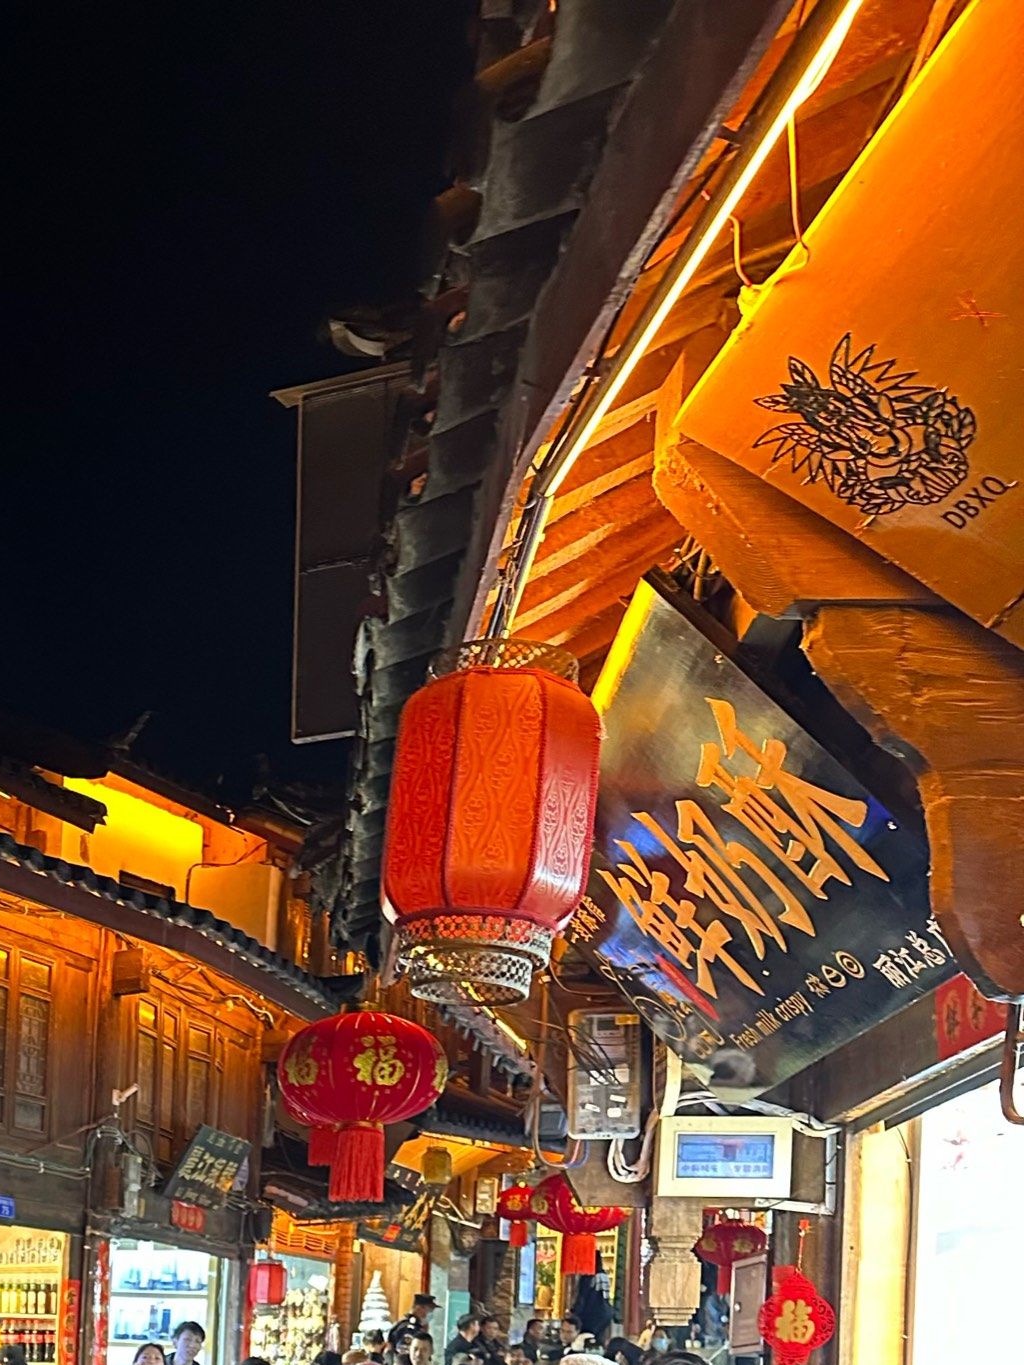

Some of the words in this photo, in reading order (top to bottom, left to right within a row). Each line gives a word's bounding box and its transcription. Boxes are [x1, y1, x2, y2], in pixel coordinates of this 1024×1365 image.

[940, 476, 1018, 530] DBXQ
[595, 697, 891, 999] 鲜奶酥
[729, 1022, 764, 1052] Fresh
[755, 1008, 783, 1037] milk
[774, 990, 815, 1023] crispy
[352, 1034, 405, 1087] 福
[775, 1299, 816, 1345] 福
